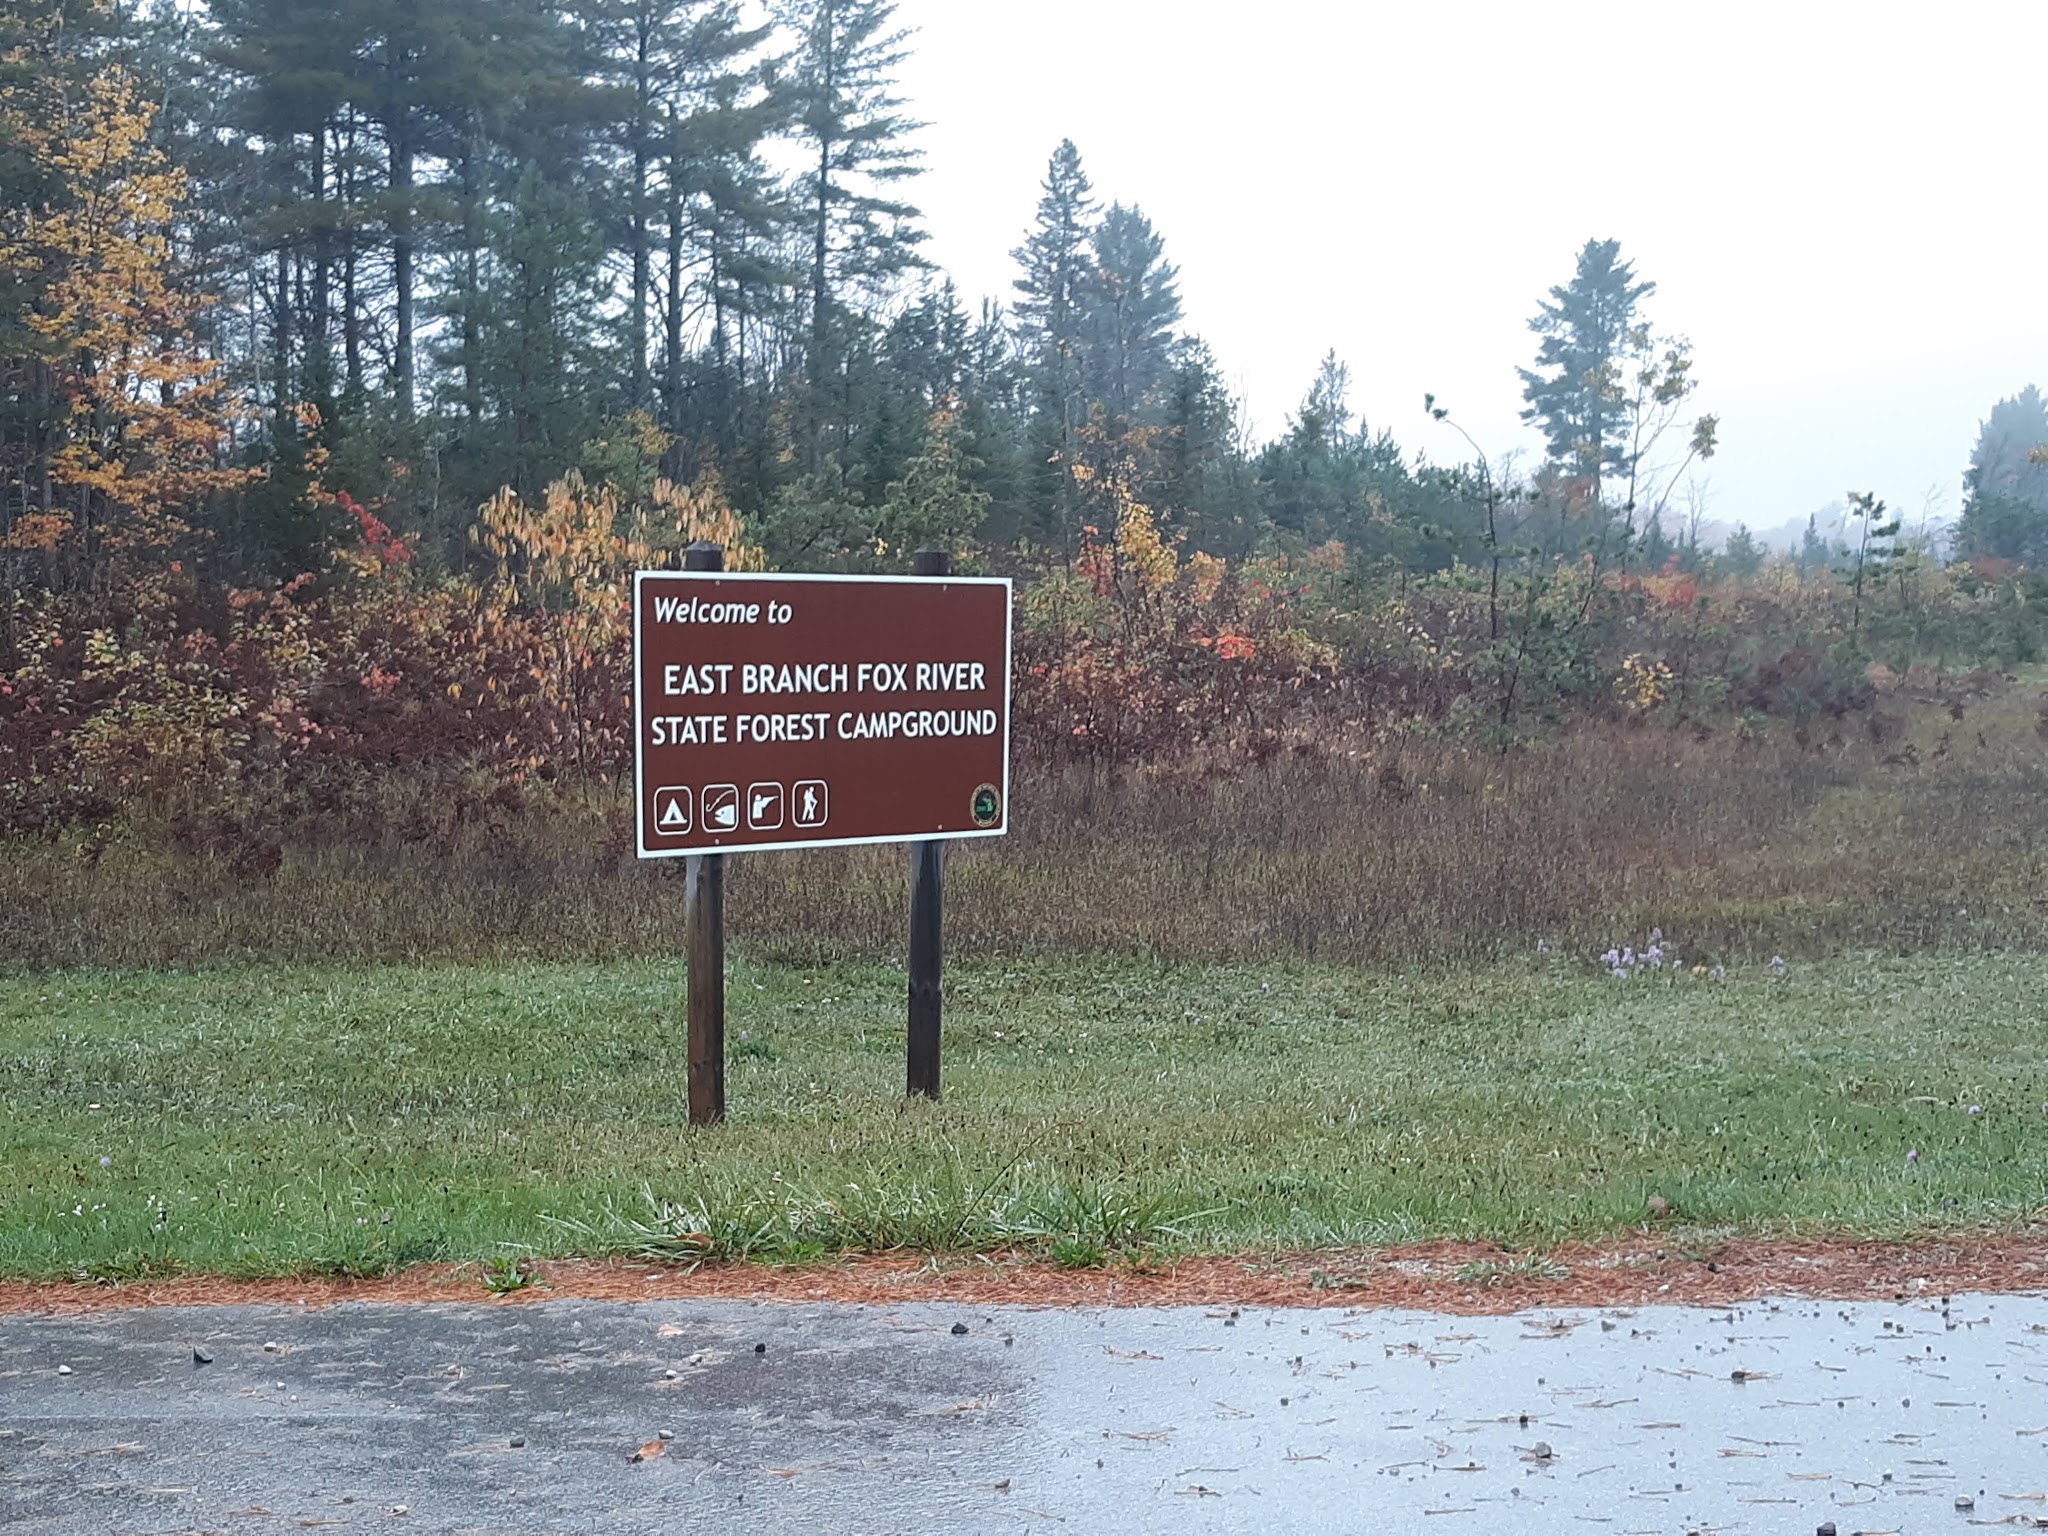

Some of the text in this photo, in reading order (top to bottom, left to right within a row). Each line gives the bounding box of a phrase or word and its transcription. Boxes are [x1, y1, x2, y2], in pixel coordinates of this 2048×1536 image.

[655, 597, 792, 623] Welcome to
[665, 663, 985, 694] EAST BRANCH FOX RIVER
[652, 710, 996, 745] STATE FOREST CAMPGROUND
